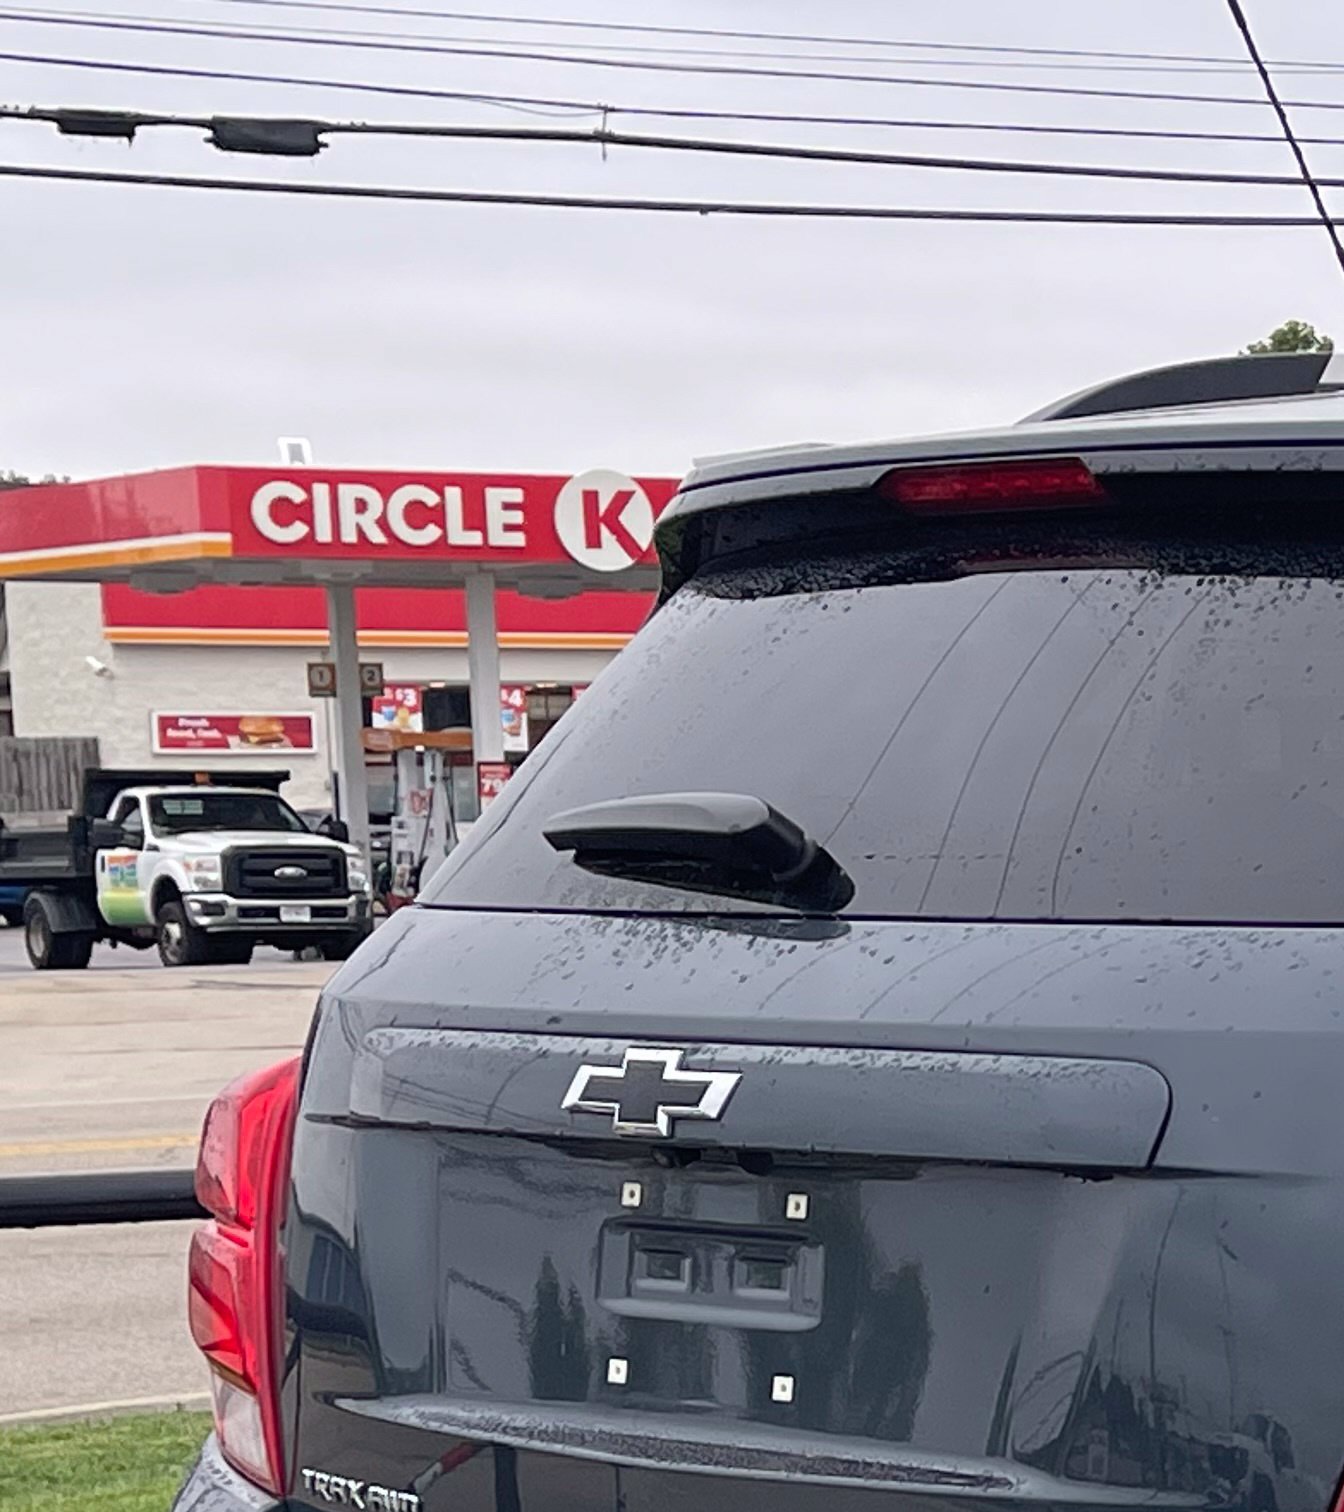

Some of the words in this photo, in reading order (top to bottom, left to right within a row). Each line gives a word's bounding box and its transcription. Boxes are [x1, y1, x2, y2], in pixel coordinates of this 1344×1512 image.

[251, 480, 526, 547] CIRCLE
[581, 489, 649, 561] K
[301, 1468, 365, 1509] TRAX
